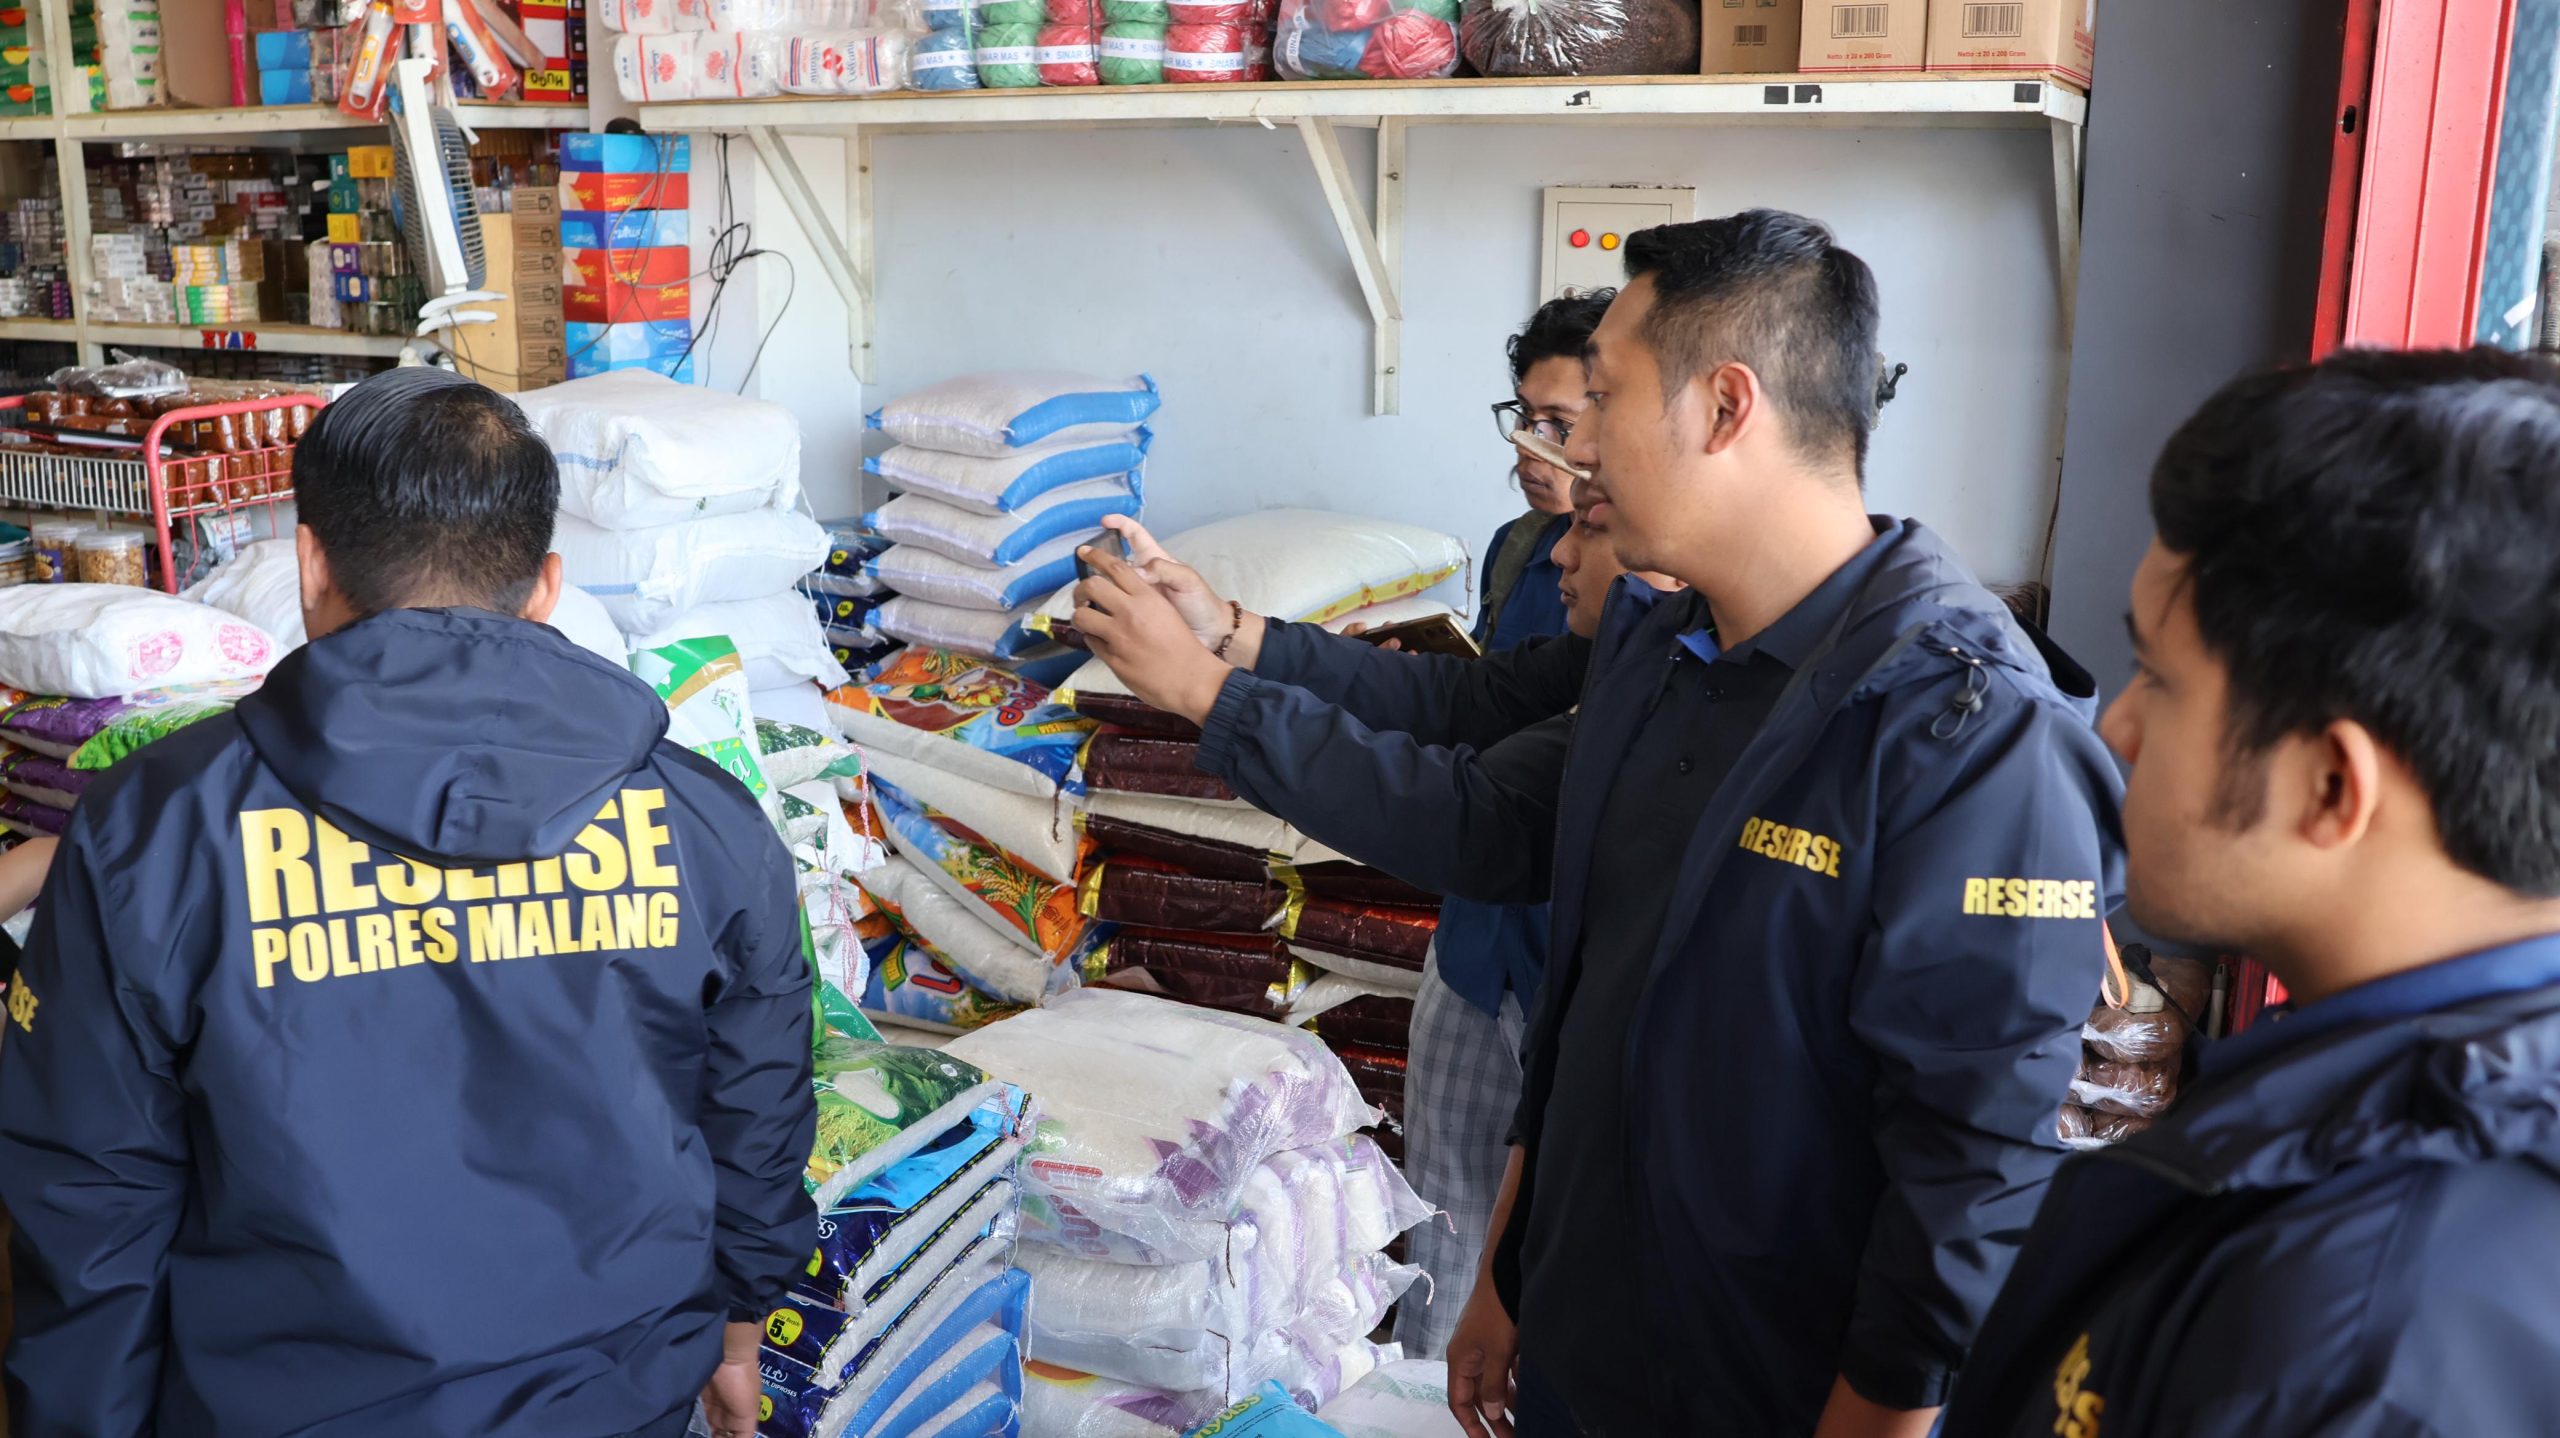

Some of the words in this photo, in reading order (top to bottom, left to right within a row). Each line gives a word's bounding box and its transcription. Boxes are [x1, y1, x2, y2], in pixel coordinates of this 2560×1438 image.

[200, 329, 257, 350] STAR
[1739, 816, 1842, 879] RESERSE
[1962, 877, 2096, 919] RESERSE
[251, 906, 459, 988] POLRES
[467, 891, 680, 964] MALANG
[769, 1317, 786, 1339] 5
[770, 1382, 798, 1399] DIPROSES
